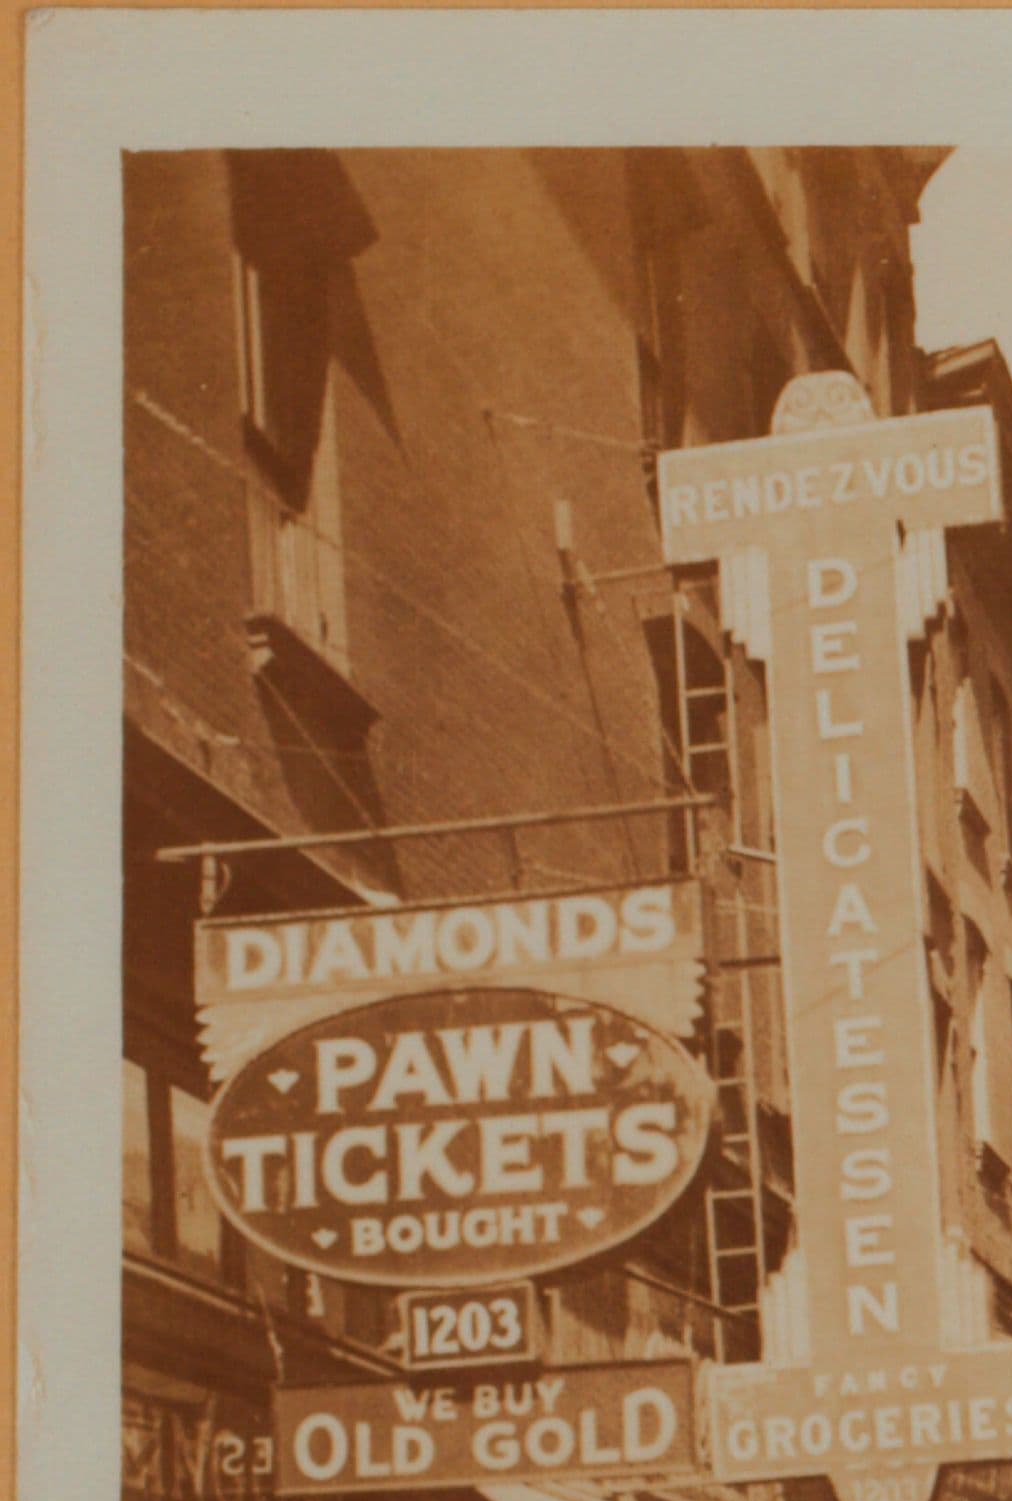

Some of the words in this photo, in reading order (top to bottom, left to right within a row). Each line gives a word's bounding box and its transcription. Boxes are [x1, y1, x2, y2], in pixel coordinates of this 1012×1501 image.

[668, 445, 988, 526] RENDEZVOUS
[226, 886, 676, 990] DIAMONDS
[806, 558, 899, 1336] DELICATESSEN
[315, 1018, 599, 1114] PAWN
[222, 1103, 681, 1213] TICKETS
[351, 1202, 569, 1255] BOUGHT
[411, 1300, 522, 1356] 1203
[393, 1386, 456, 1421] WE
[473, 1379, 565, 1416] BUY
[814, 1363, 947, 1397] FANCY
[294, 1412, 434, 1480] OLD
[472, 1387, 677, 1470] GOLD
